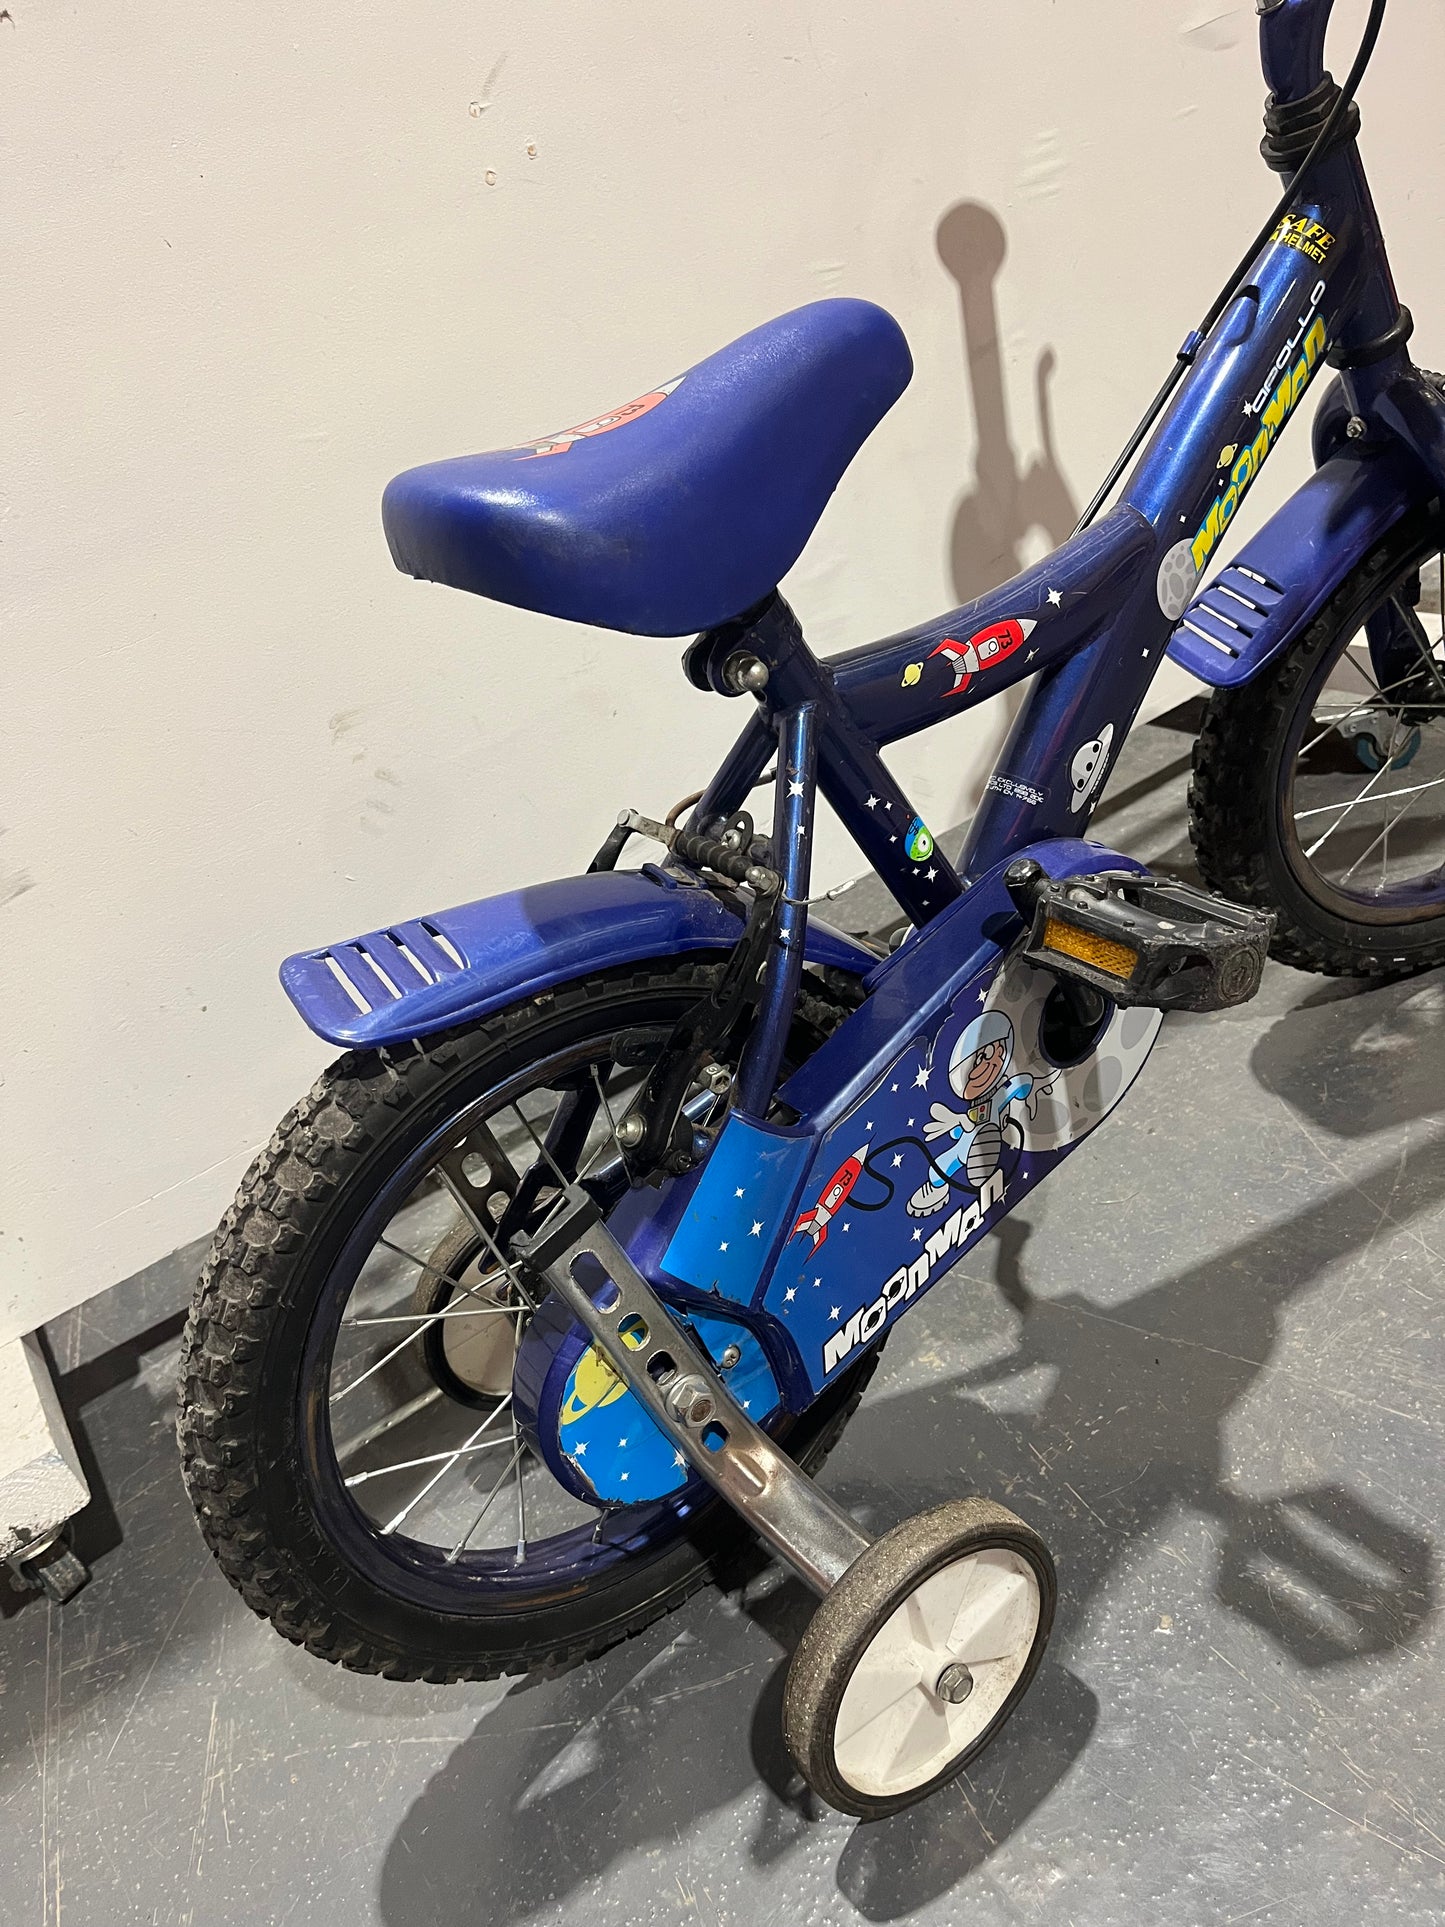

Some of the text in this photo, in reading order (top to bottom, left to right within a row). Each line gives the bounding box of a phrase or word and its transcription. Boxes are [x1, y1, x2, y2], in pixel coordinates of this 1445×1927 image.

[1277, 213, 1336, 250] SAFE
[1282, 232, 1327, 264] HELMET
[998, 629, 1013, 649] 73
[838, 1169, 853, 1187] 73
